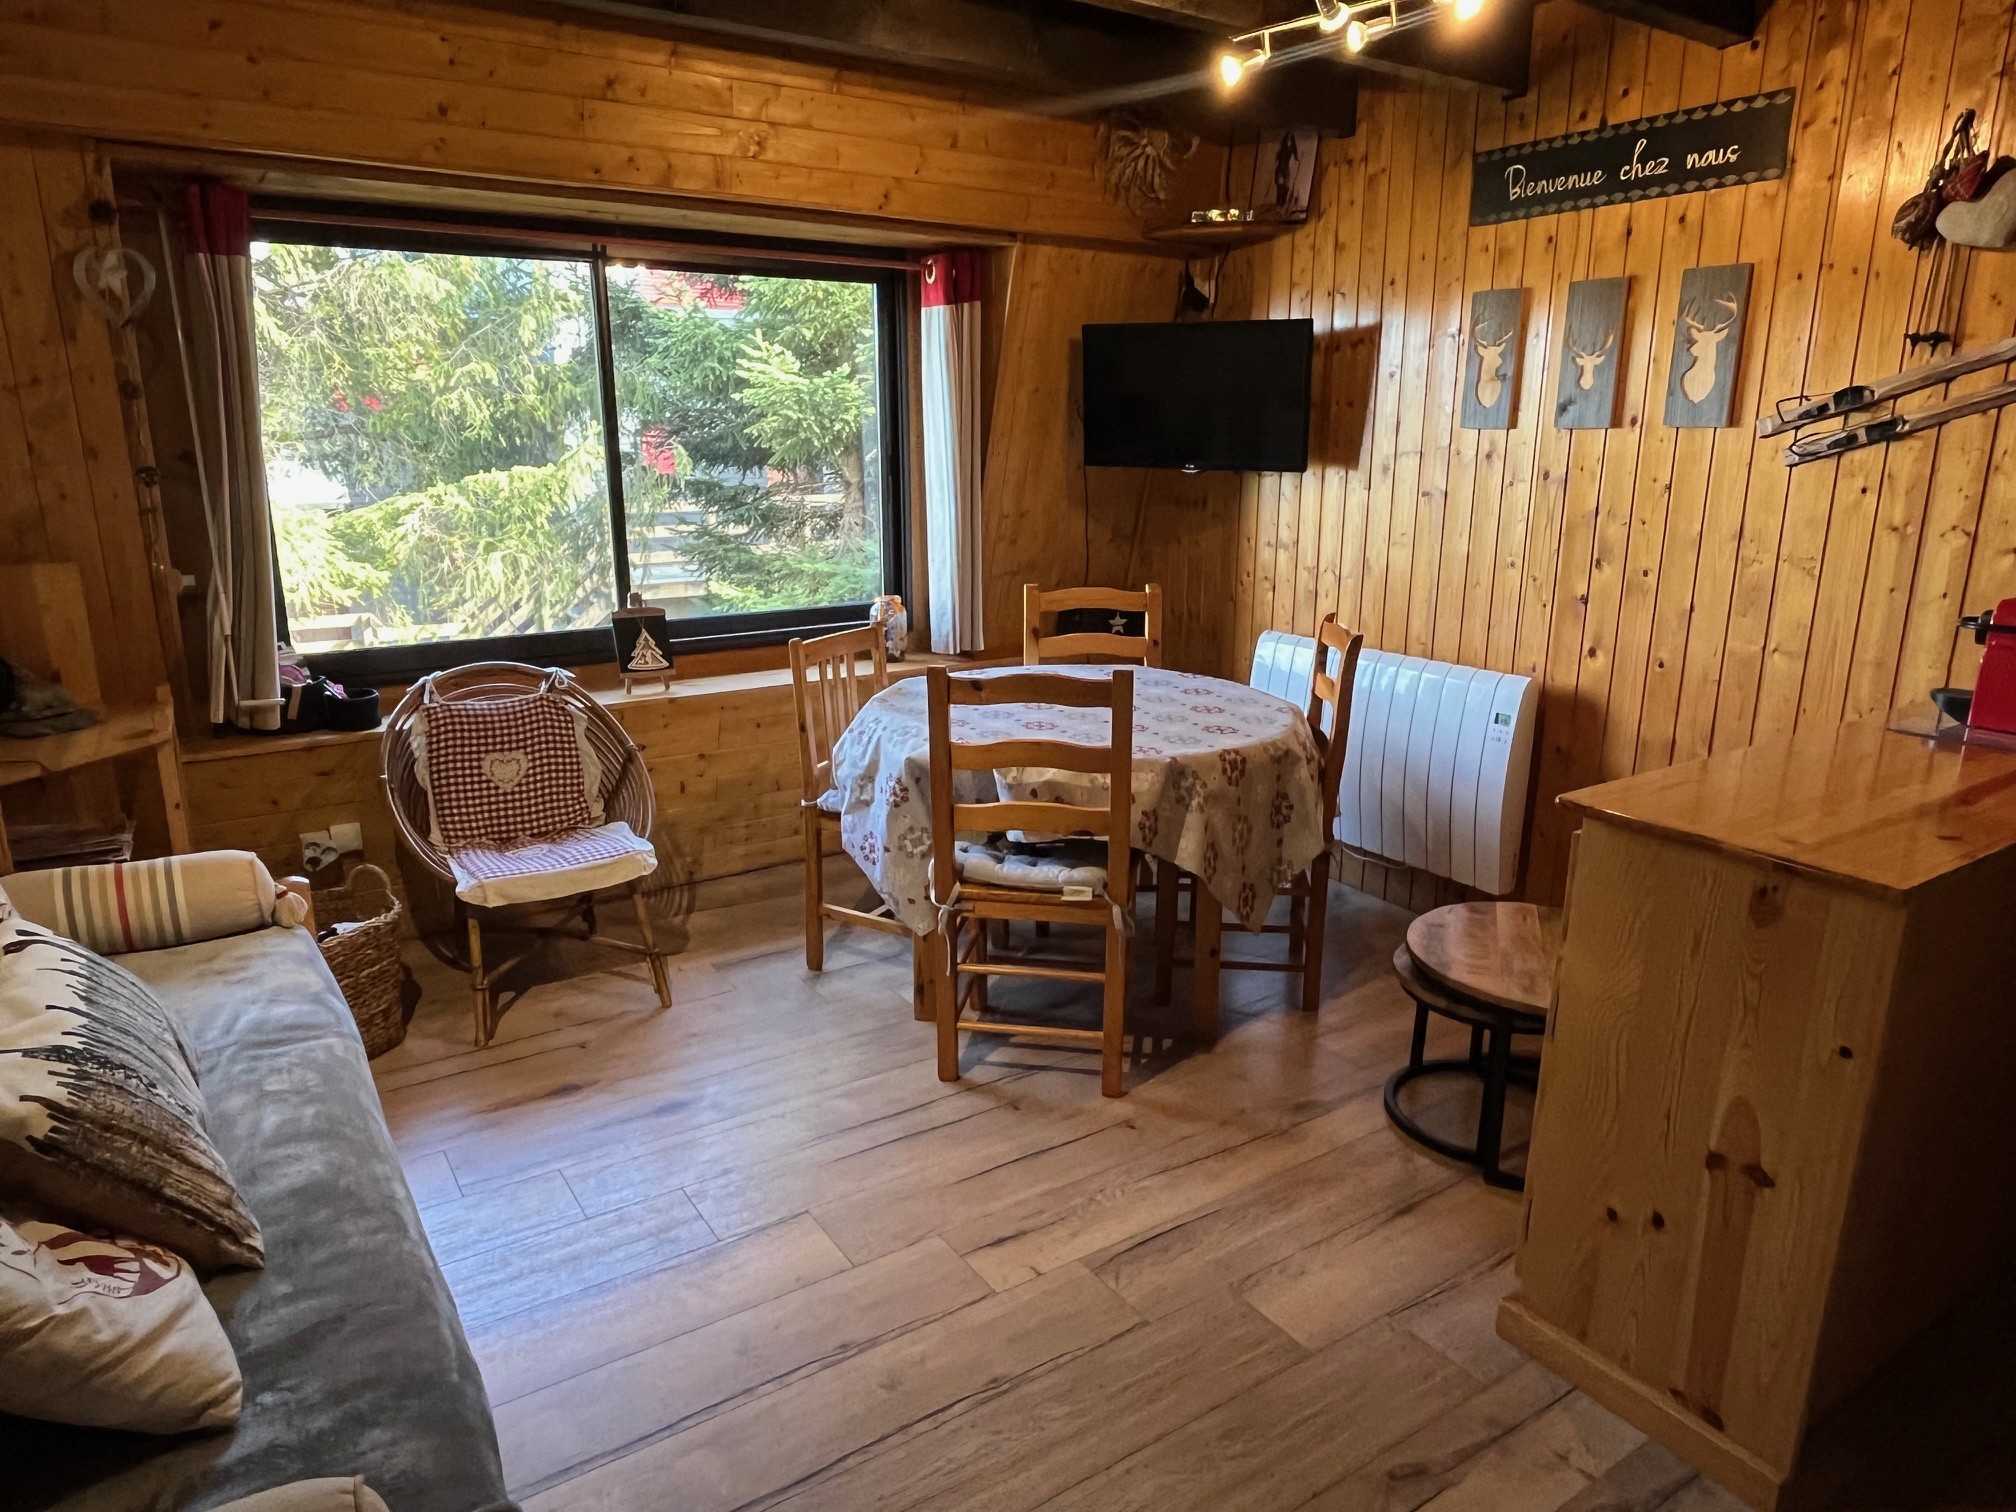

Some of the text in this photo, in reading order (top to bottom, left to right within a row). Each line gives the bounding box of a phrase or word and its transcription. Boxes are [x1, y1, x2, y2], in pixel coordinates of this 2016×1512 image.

[1504, 138, 1741, 201] Bienvenue chez nous
